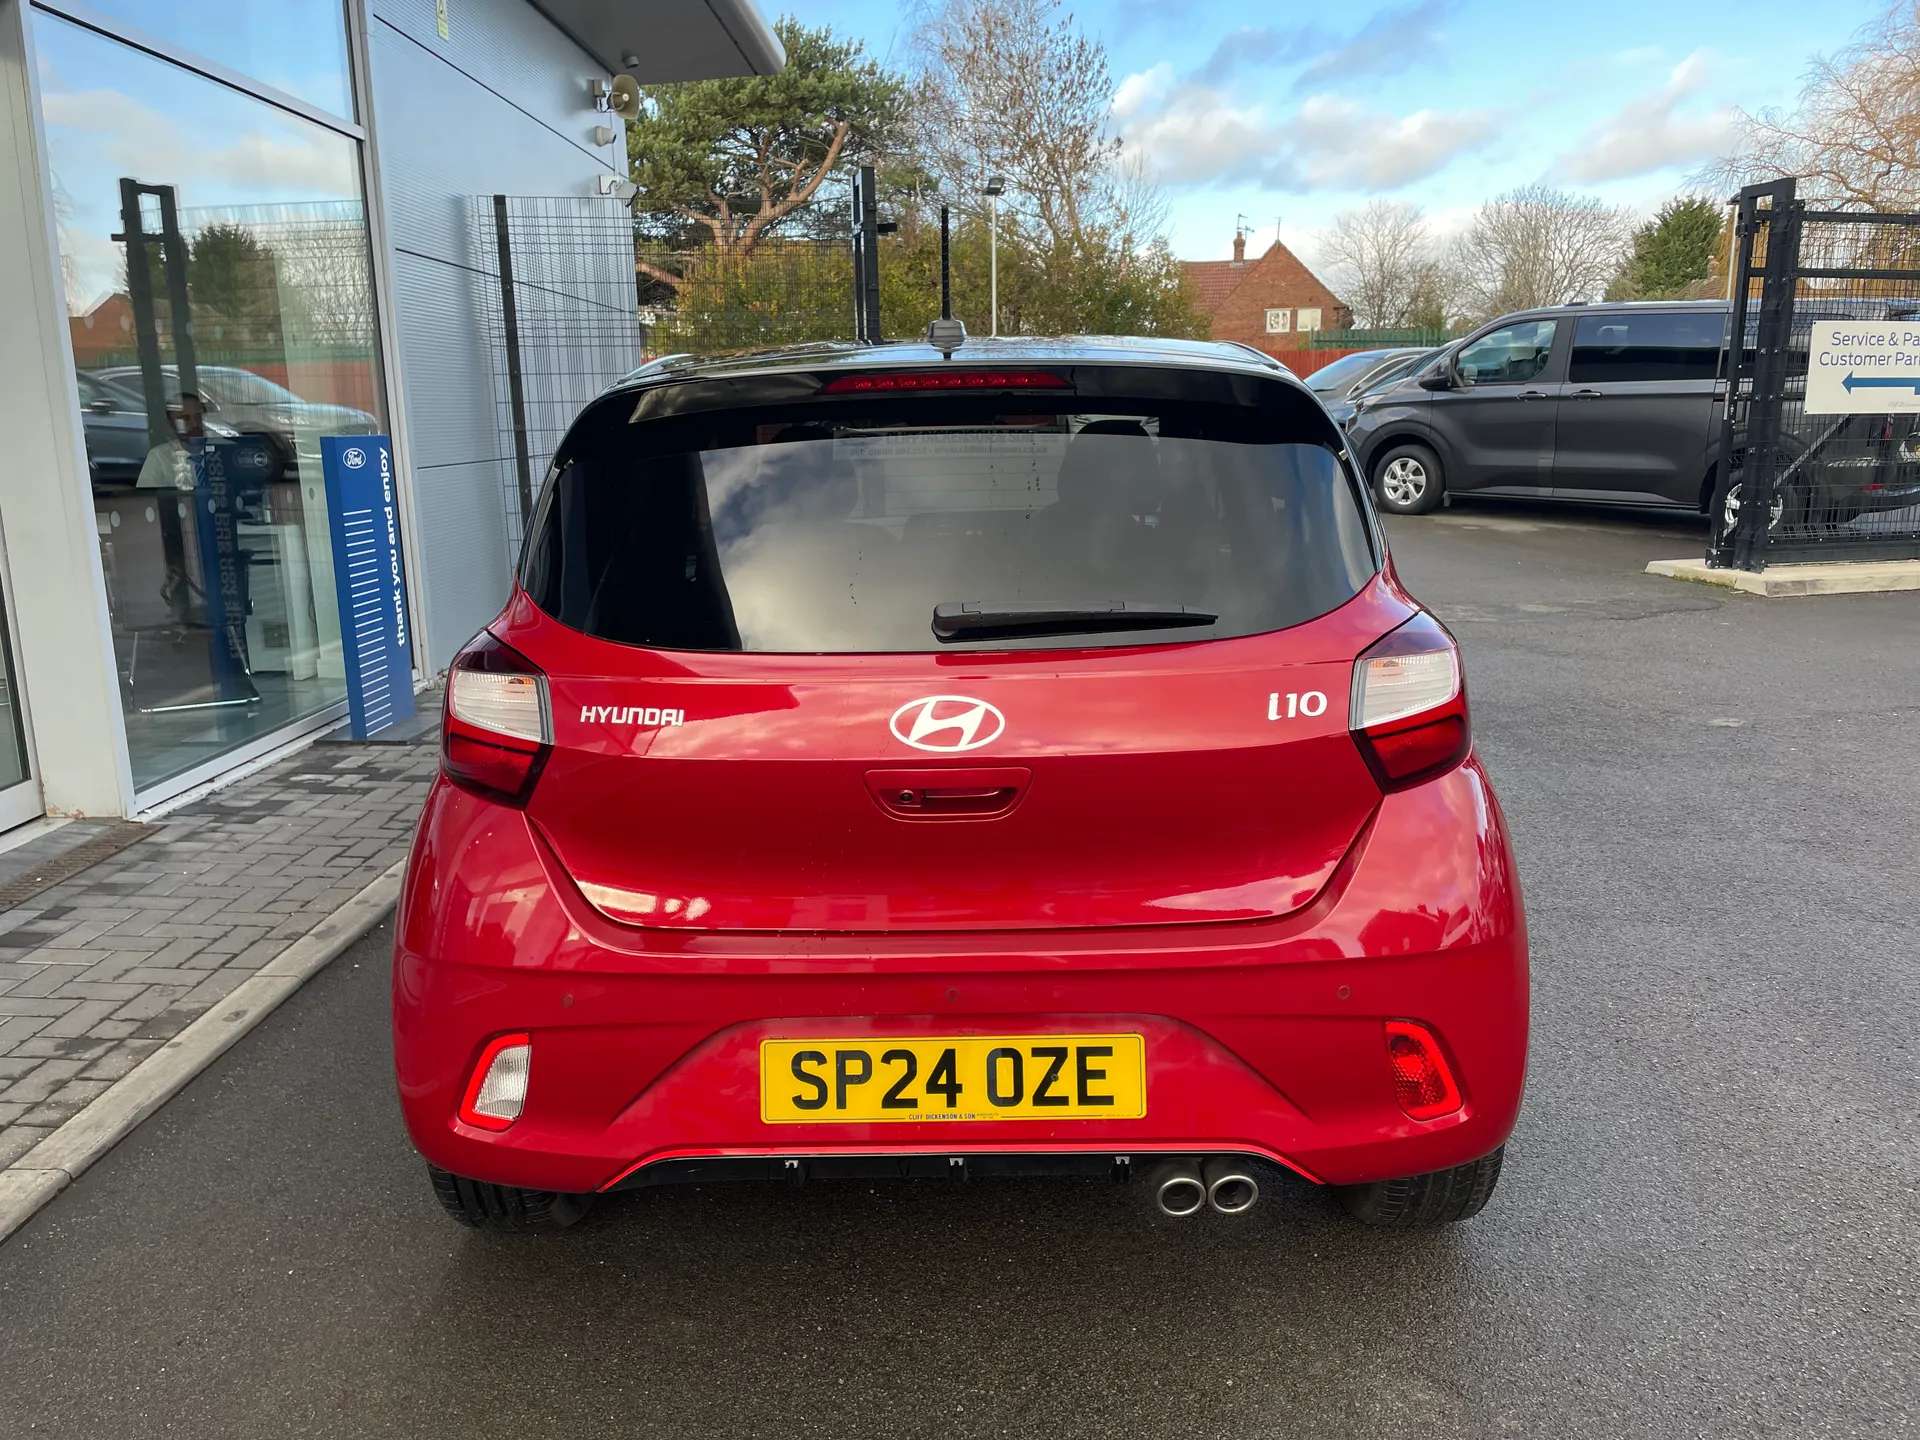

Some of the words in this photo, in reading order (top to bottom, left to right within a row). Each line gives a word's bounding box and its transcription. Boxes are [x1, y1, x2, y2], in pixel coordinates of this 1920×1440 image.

[1831, 331, 1884, 347] Service
[1888, 331, 1898, 347] &
[1819, 351, 1892, 367] Customer
[1895, 352, 1920, 367] Par
[346, 450, 364, 467] Ford
[379, 447, 391, 503] enjoy
[383, 506, 396, 546] and
[390, 549, 402, 588] you
[393, 589, 406, 648] thank
[580, 705, 685, 727] HYUNDAI
[790, 1048, 963, 1110] SP24
[986, 1046, 1115, 1108] OZE
[964, 1112, 976, 1120] SON
